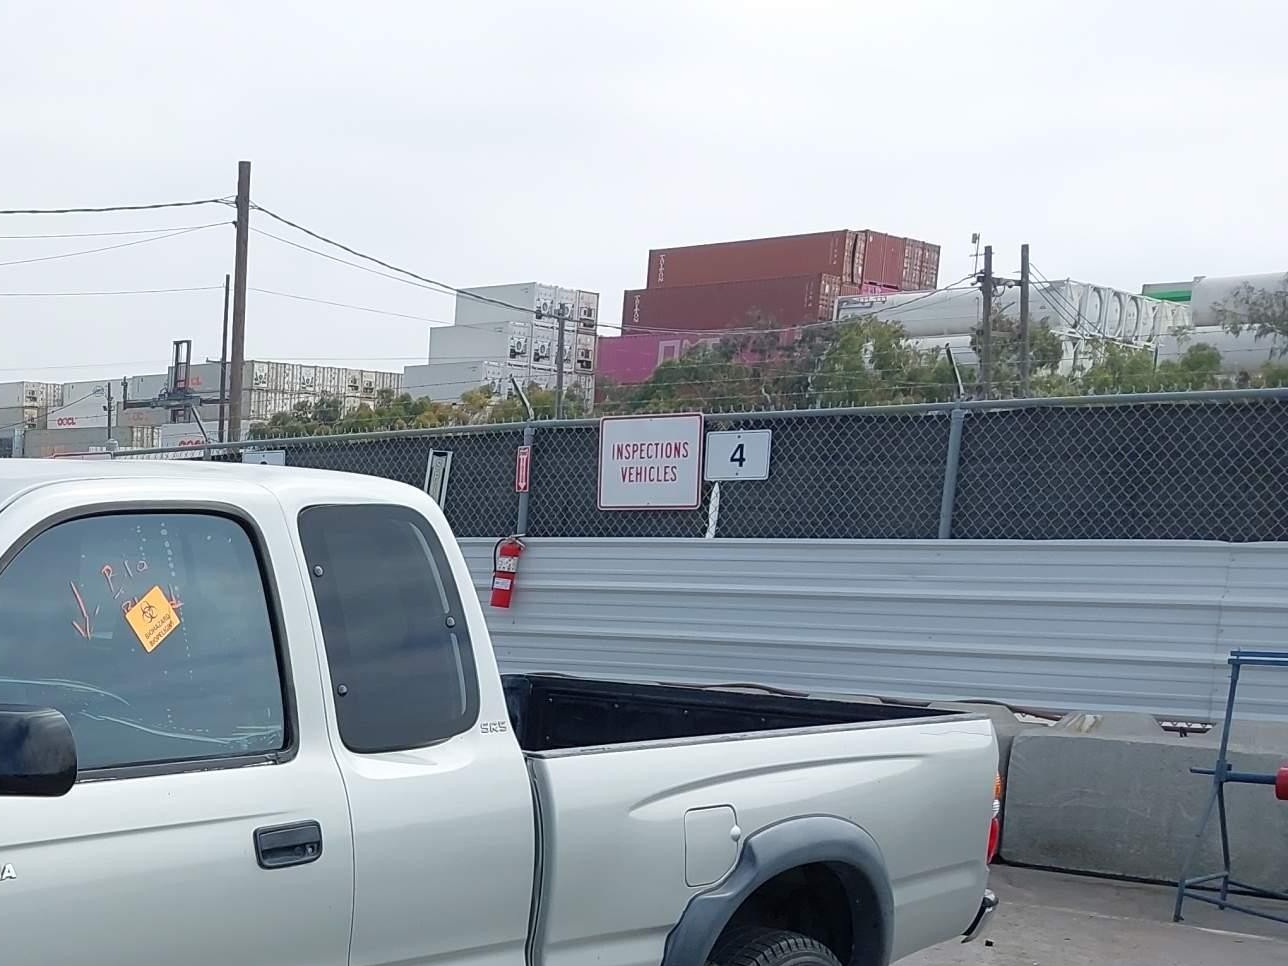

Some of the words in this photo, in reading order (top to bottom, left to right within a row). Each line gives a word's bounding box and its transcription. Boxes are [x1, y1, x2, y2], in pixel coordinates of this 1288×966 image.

[56, 417, 77, 426] OOCL
[611, 442, 690, 460] INSPECTIONS
[729, 443, 746, 467] 4
[621, 465, 678, 483] VEHICLES
